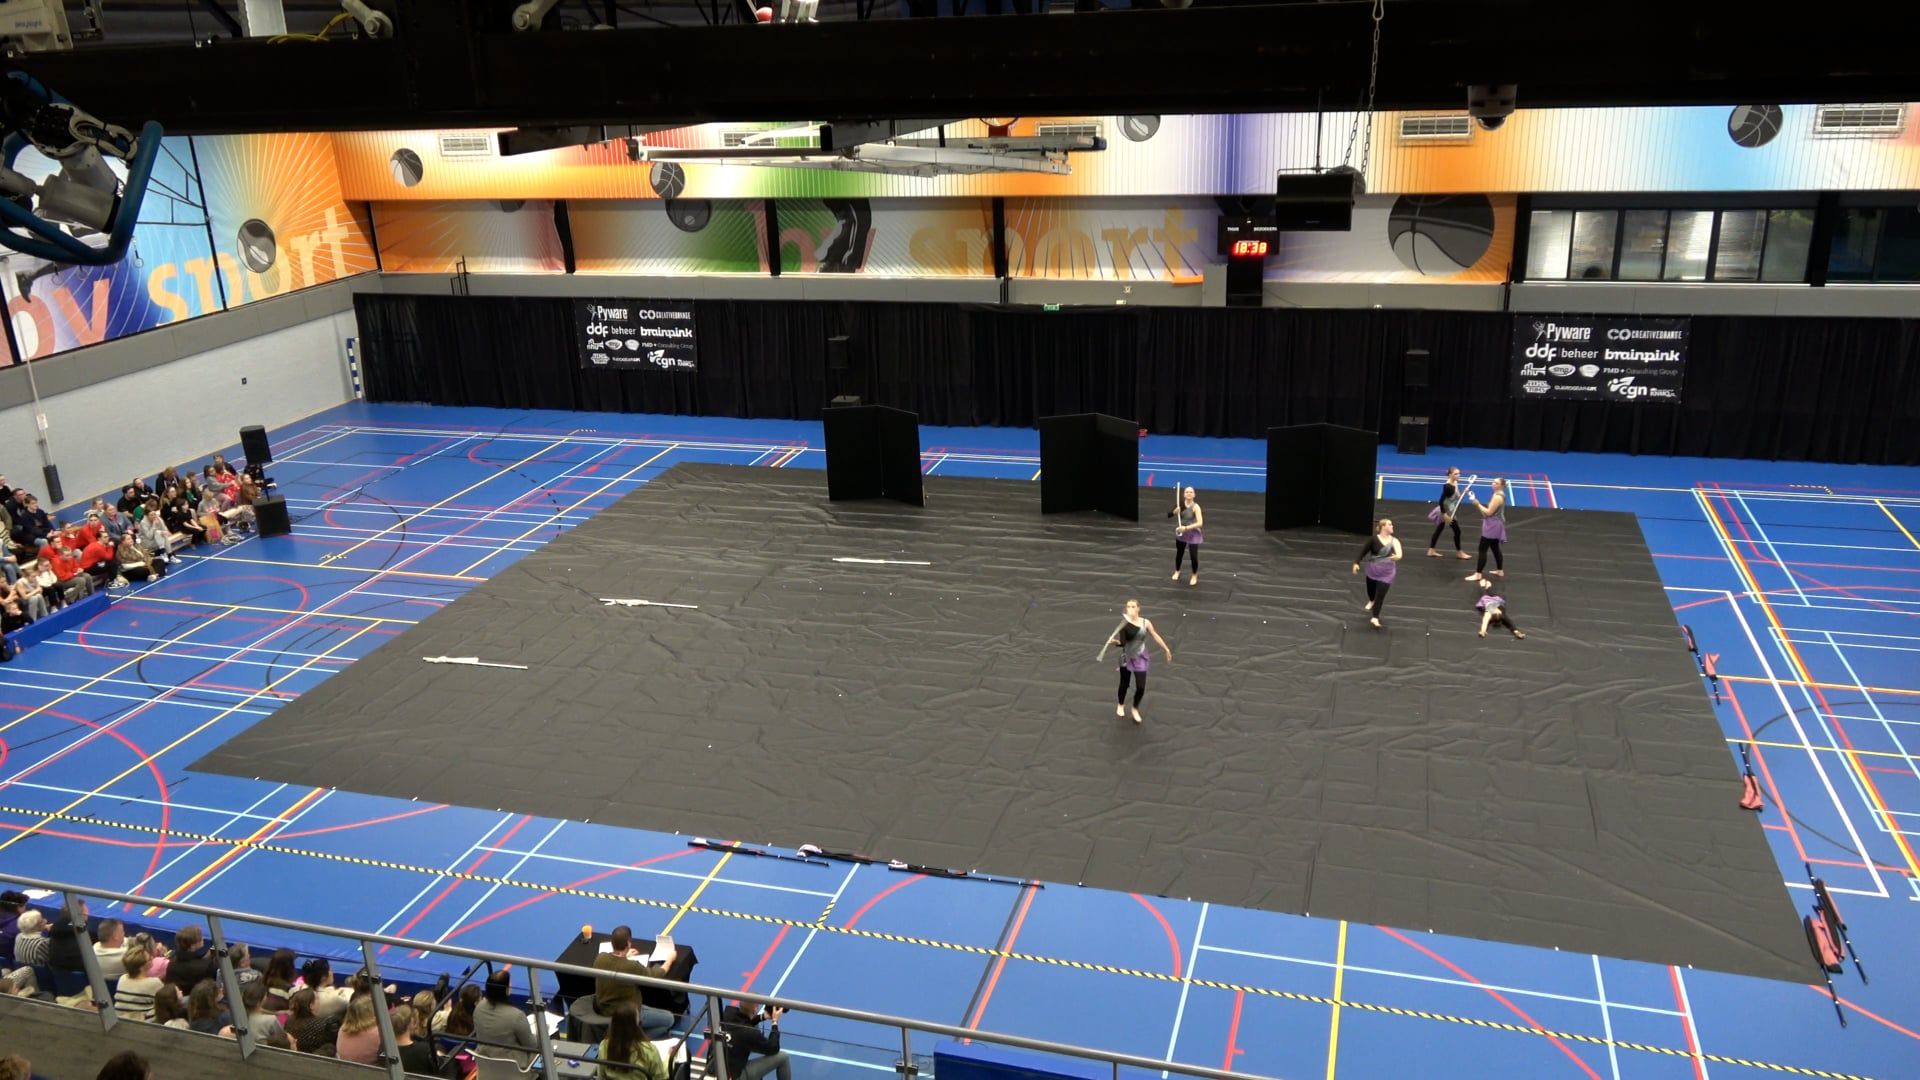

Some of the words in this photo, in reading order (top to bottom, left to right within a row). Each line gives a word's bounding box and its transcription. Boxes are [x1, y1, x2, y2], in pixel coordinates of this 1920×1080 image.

[597, 305, 628, 321] Pyware
[586, 322, 608, 338] ddf
[611, 325, 636, 335] beheer
[640, 326, 693, 339] brainpink
[1547, 323, 1591, 341] Pyware
[1525, 342, 1557, 361] ddf
[1561, 347, 1599, 358] beheer
[1604, 348, 1680, 363] brainpink
[655, 357, 676, 368] cgn
[1619, 386, 1648, 399] cgn
